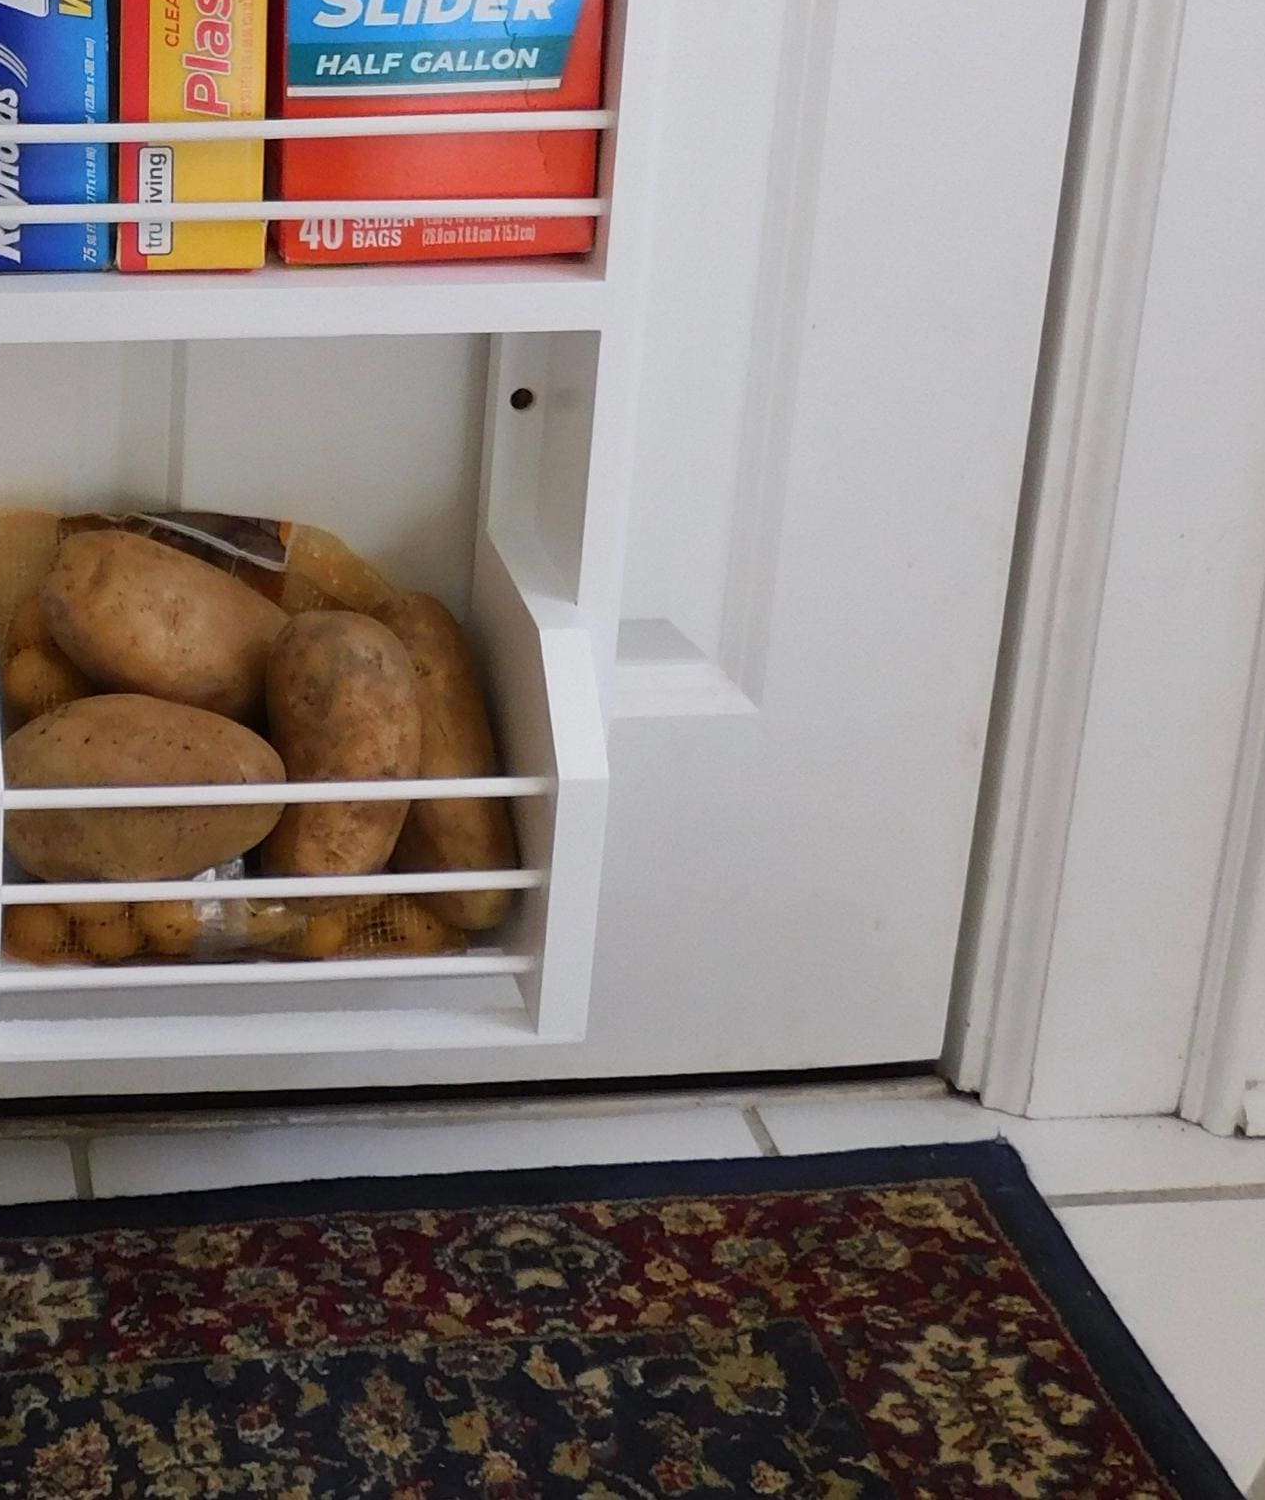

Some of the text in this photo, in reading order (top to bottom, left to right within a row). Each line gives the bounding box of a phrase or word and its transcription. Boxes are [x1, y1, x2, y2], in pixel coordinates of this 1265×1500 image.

[315, 48, 539, 76] HALF GALLON
[146, 153, 167, 248] truiving
[299, 217, 344, 251] 40
[351, 229, 403, 249] BAGS
[83, 247, 97, 263] 75
